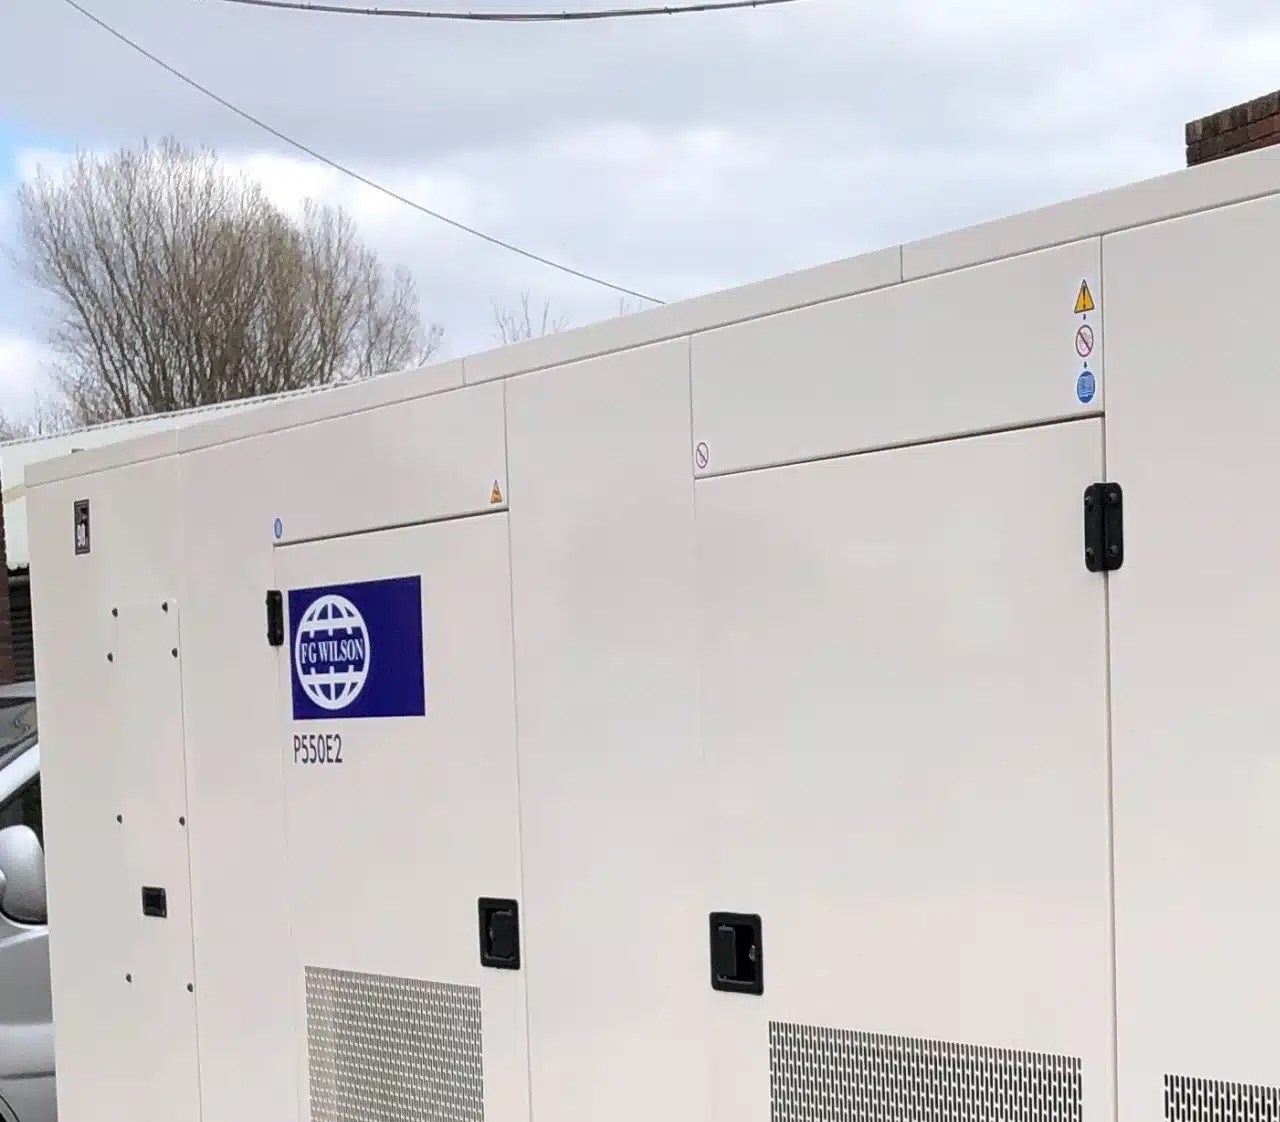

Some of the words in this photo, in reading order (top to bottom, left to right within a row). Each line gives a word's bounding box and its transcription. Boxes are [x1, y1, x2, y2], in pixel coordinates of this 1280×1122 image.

[302, 641, 316, 664] FG
[319, 639, 364, 662] WILSON
[293, 734, 343, 764] P550E2
